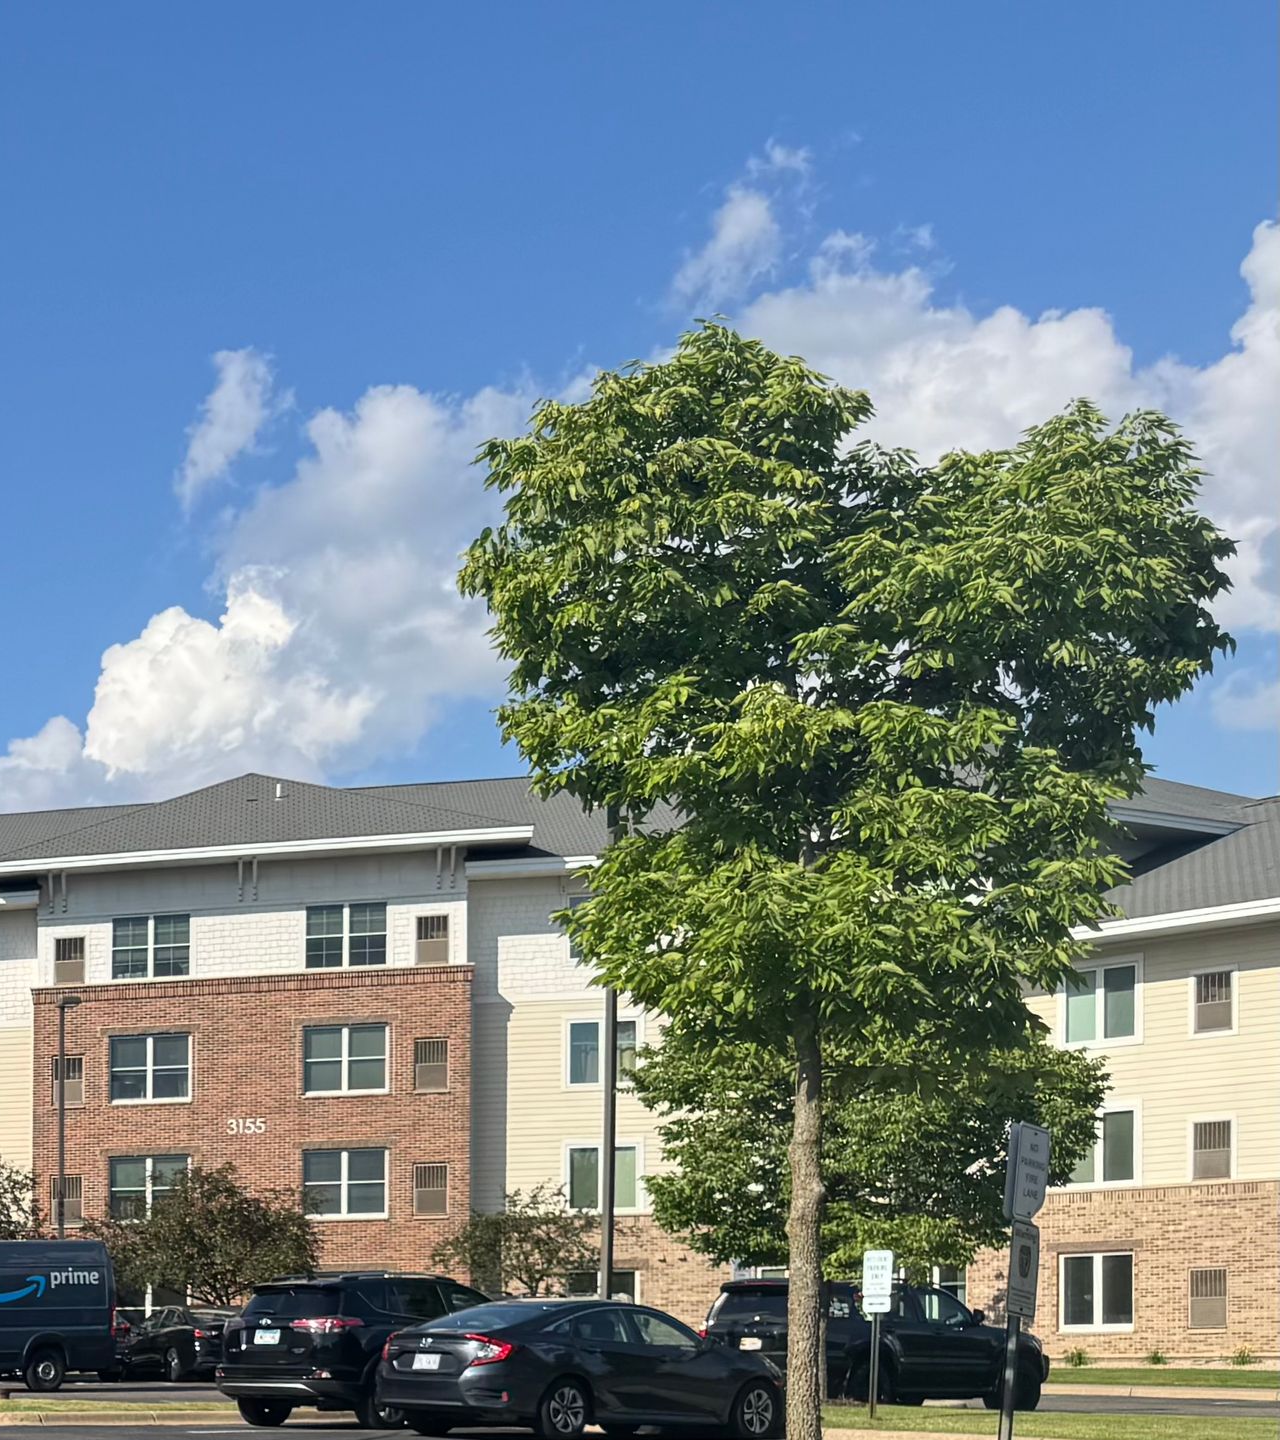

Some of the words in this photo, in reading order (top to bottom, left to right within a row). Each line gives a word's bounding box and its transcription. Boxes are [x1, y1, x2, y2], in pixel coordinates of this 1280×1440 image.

[227, 1117, 267, 1135] 3155
[1023, 1188, 1039, 1200] LANE
[50, 1266, 100, 1289] prime
